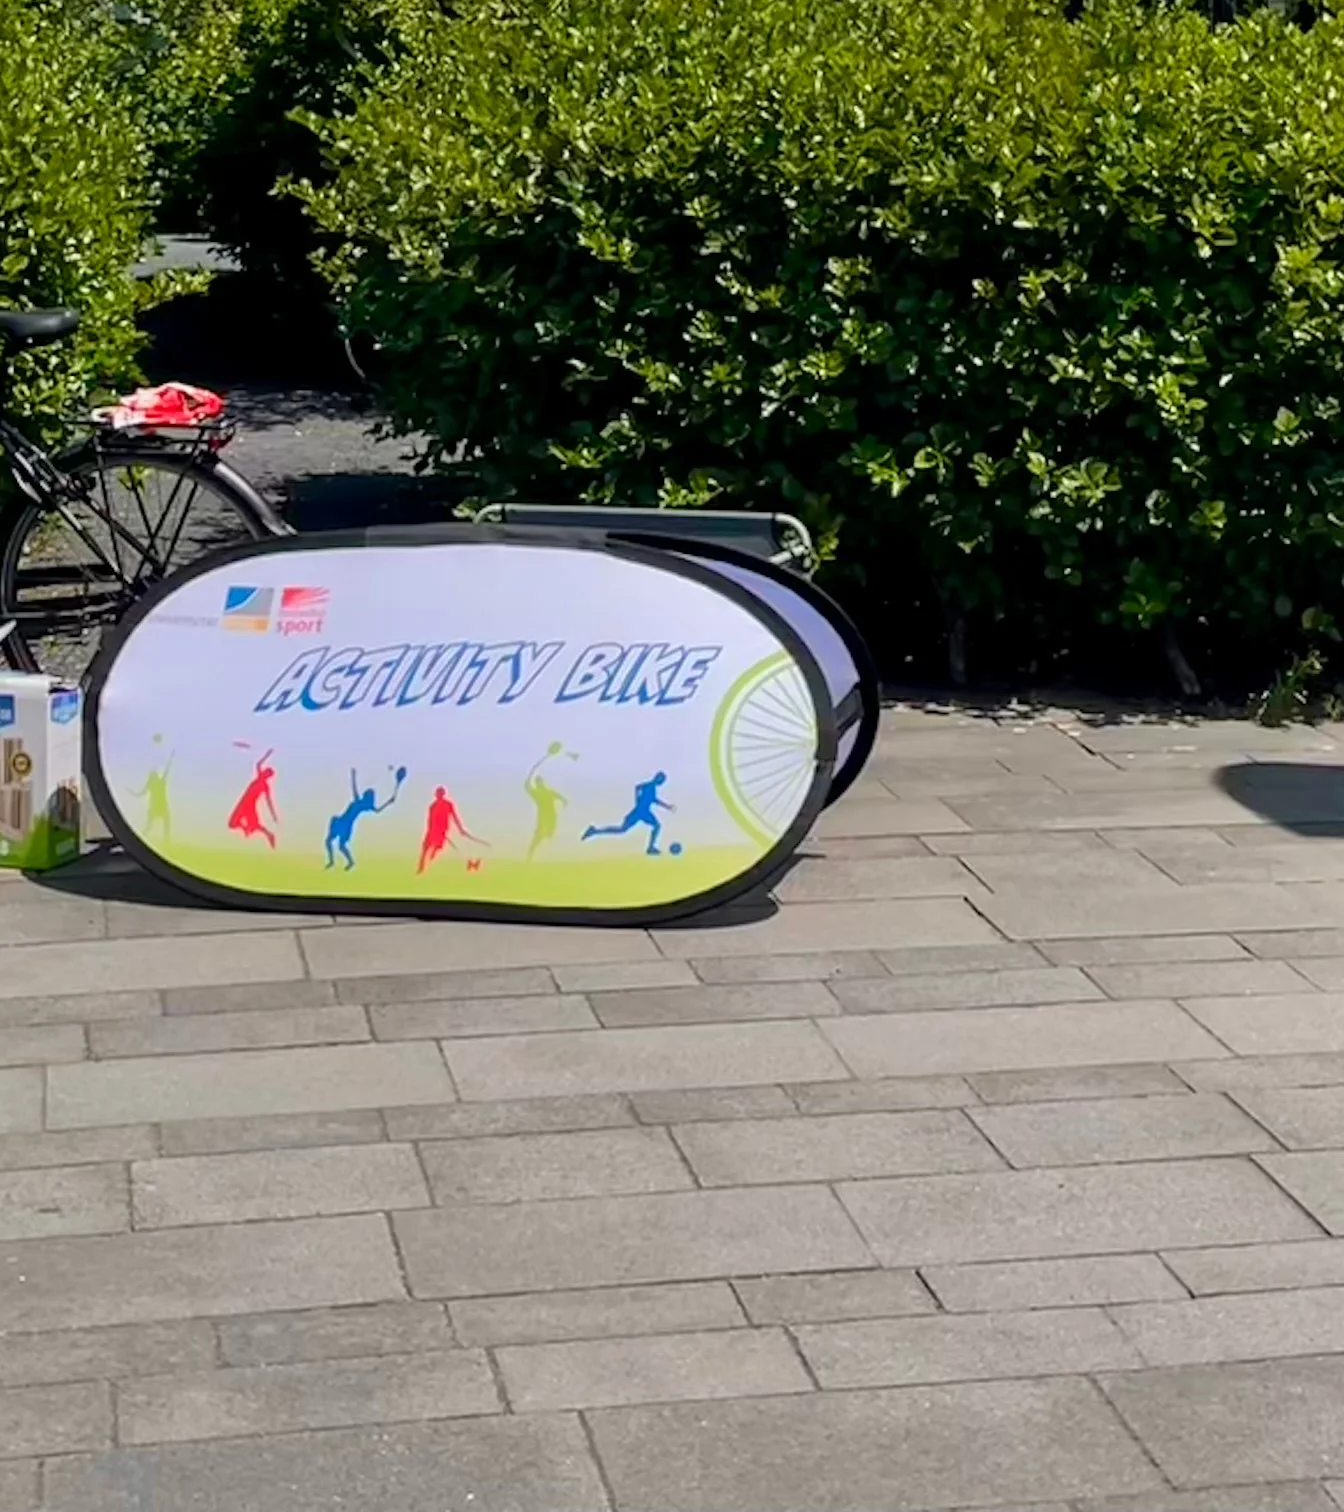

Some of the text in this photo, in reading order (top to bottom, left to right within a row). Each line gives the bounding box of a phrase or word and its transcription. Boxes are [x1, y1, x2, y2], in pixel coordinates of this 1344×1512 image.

[276, 618, 323, 637] sport
[254, 641, 723, 711] ACTIVITY BIKE
